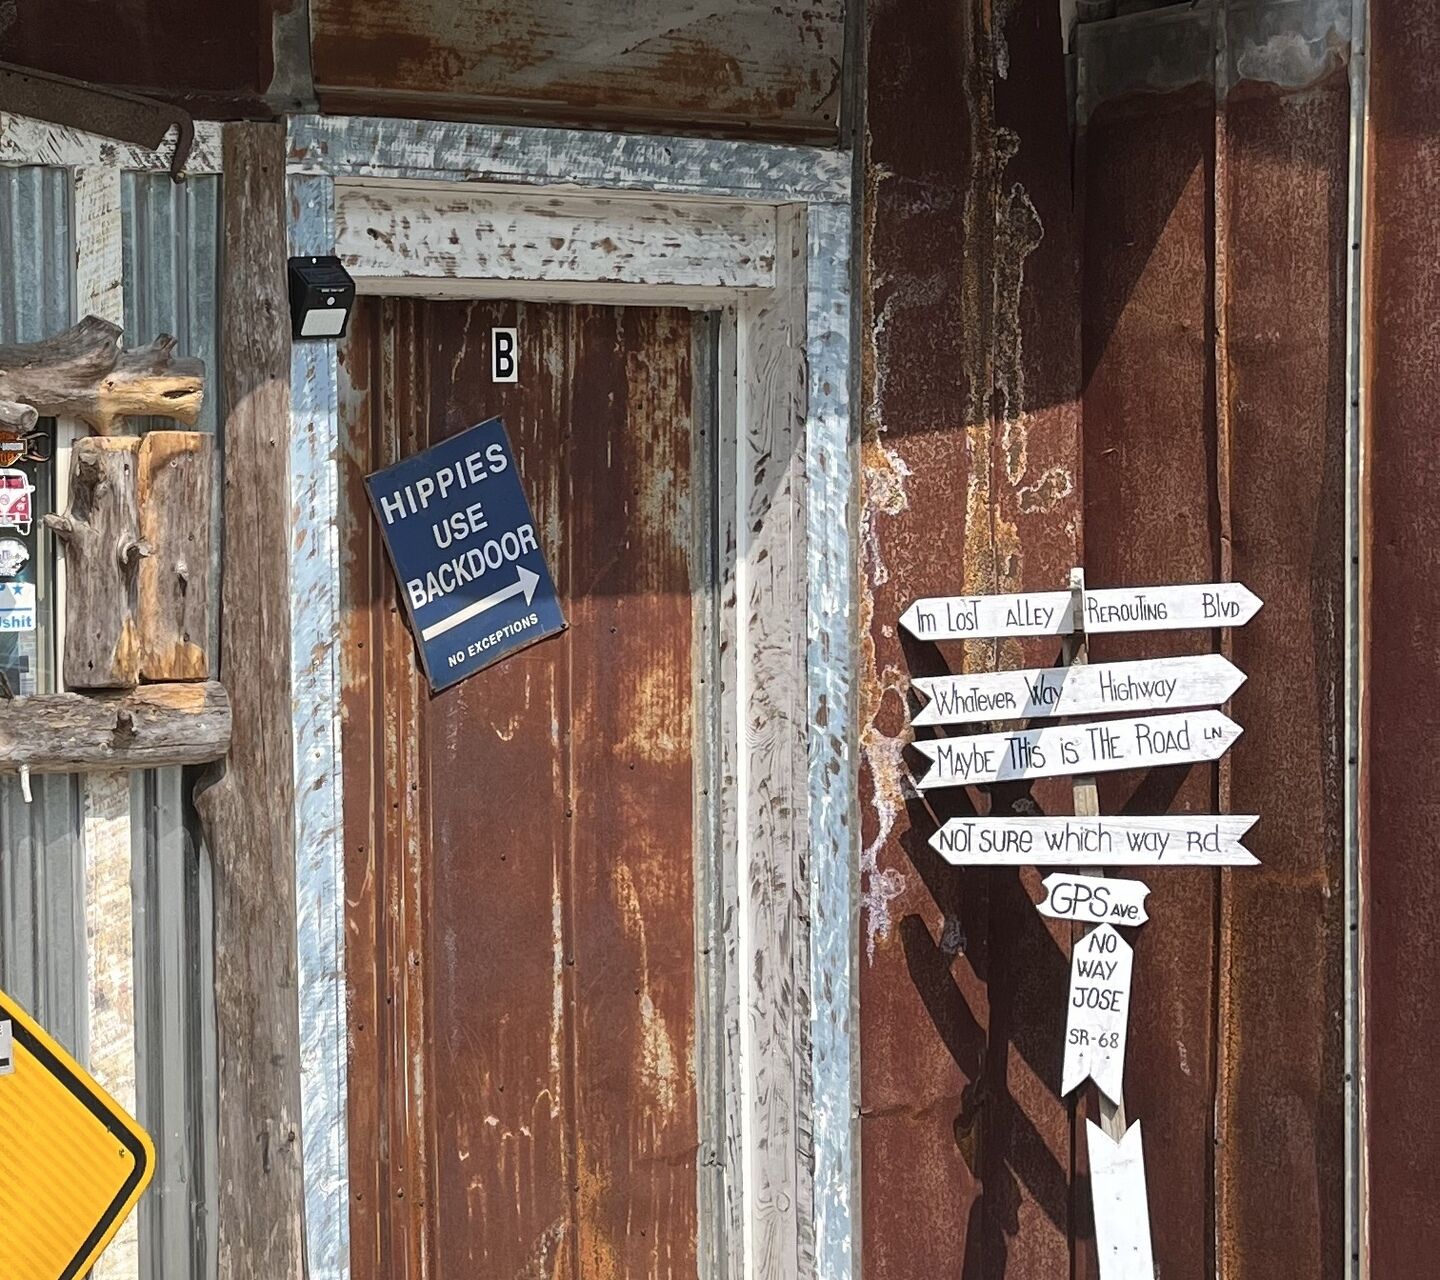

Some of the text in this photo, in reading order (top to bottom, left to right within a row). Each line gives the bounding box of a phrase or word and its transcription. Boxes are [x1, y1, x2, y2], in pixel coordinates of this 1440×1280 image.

[495, 331, 514, 378] B
[380, 443, 508, 525] HIPPIES
[432, 502, 488, 550] USE
[406, 523, 539, 610] BACKDOOR
[448, 613, 539, 668] NO EXCEPTIONS
[1024, 674, 1063, 712] Way
[1204, 726, 1223, 740] LN
[939, 823, 976, 852] NOT
[1044, 823, 1112, 853] which
[1126, 830, 1171, 860] way
[1050, 883, 1111, 918] GPS
[1088, 933, 1117, 953] NO
[1076, 958, 1118, 981] WAY
[1072, 986, 1124, 1012] JOSE
[1068, 1029, 1120, 1049] SR-68
